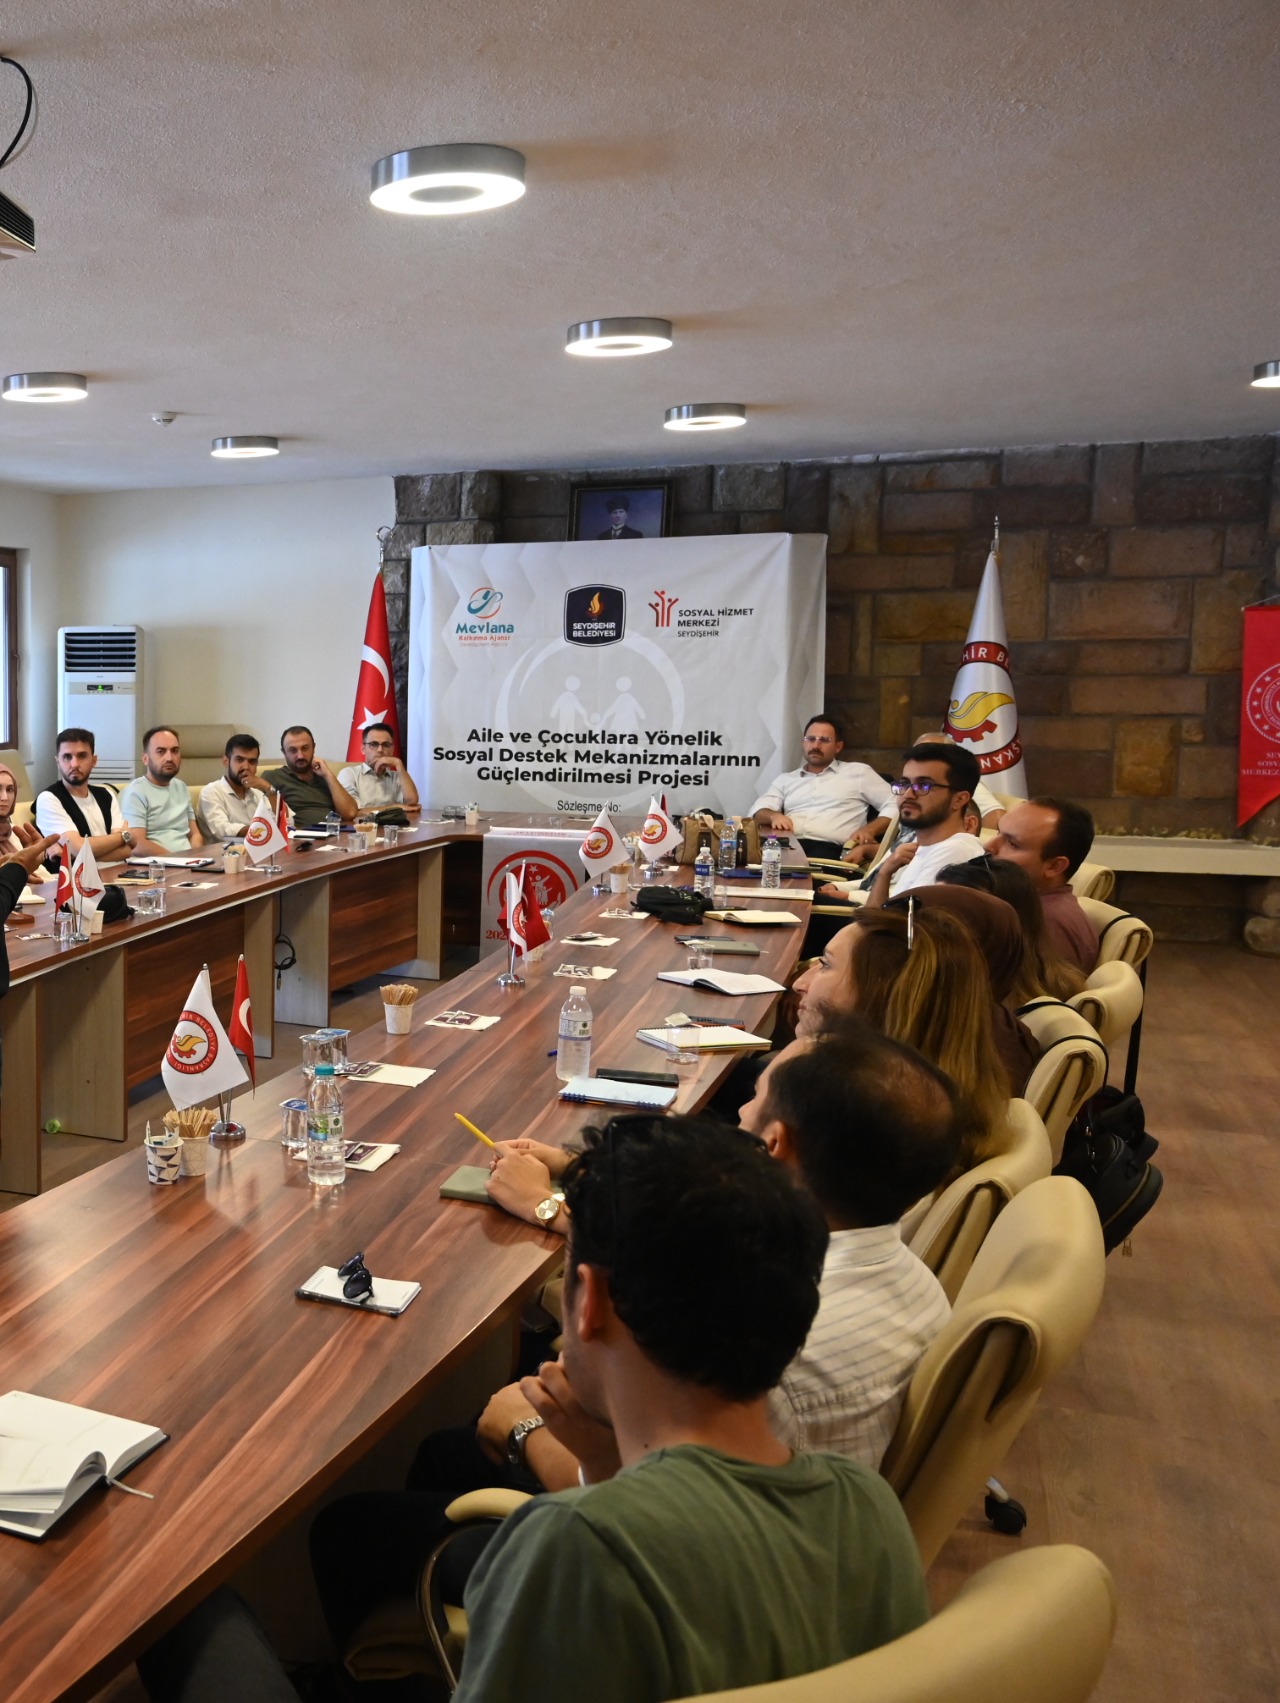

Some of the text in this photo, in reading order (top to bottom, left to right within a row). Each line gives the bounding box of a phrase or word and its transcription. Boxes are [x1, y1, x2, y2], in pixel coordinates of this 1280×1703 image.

[678, 607, 754, 617] SOSYAL HİZMET
[455, 622, 515, 634] Mevlana
[572, 622, 616, 631] SEYDİŞEHİR
[677, 618, 720, 627] MERKEZİ
[572, 629, 616, 638] BELEDİYESİ
[677, 629, 720, 638] SEYDİŞEHİR
[467, 728, 723, 747] Aile ve Çocuklara Yönelik
[433, 747, 761, 767] Sosyal Destek Mekanizmalarının
[476, 766, 710, 788] Güçlendirilmesi Projesi
[557, 800, 603, 815] Sözleşme
